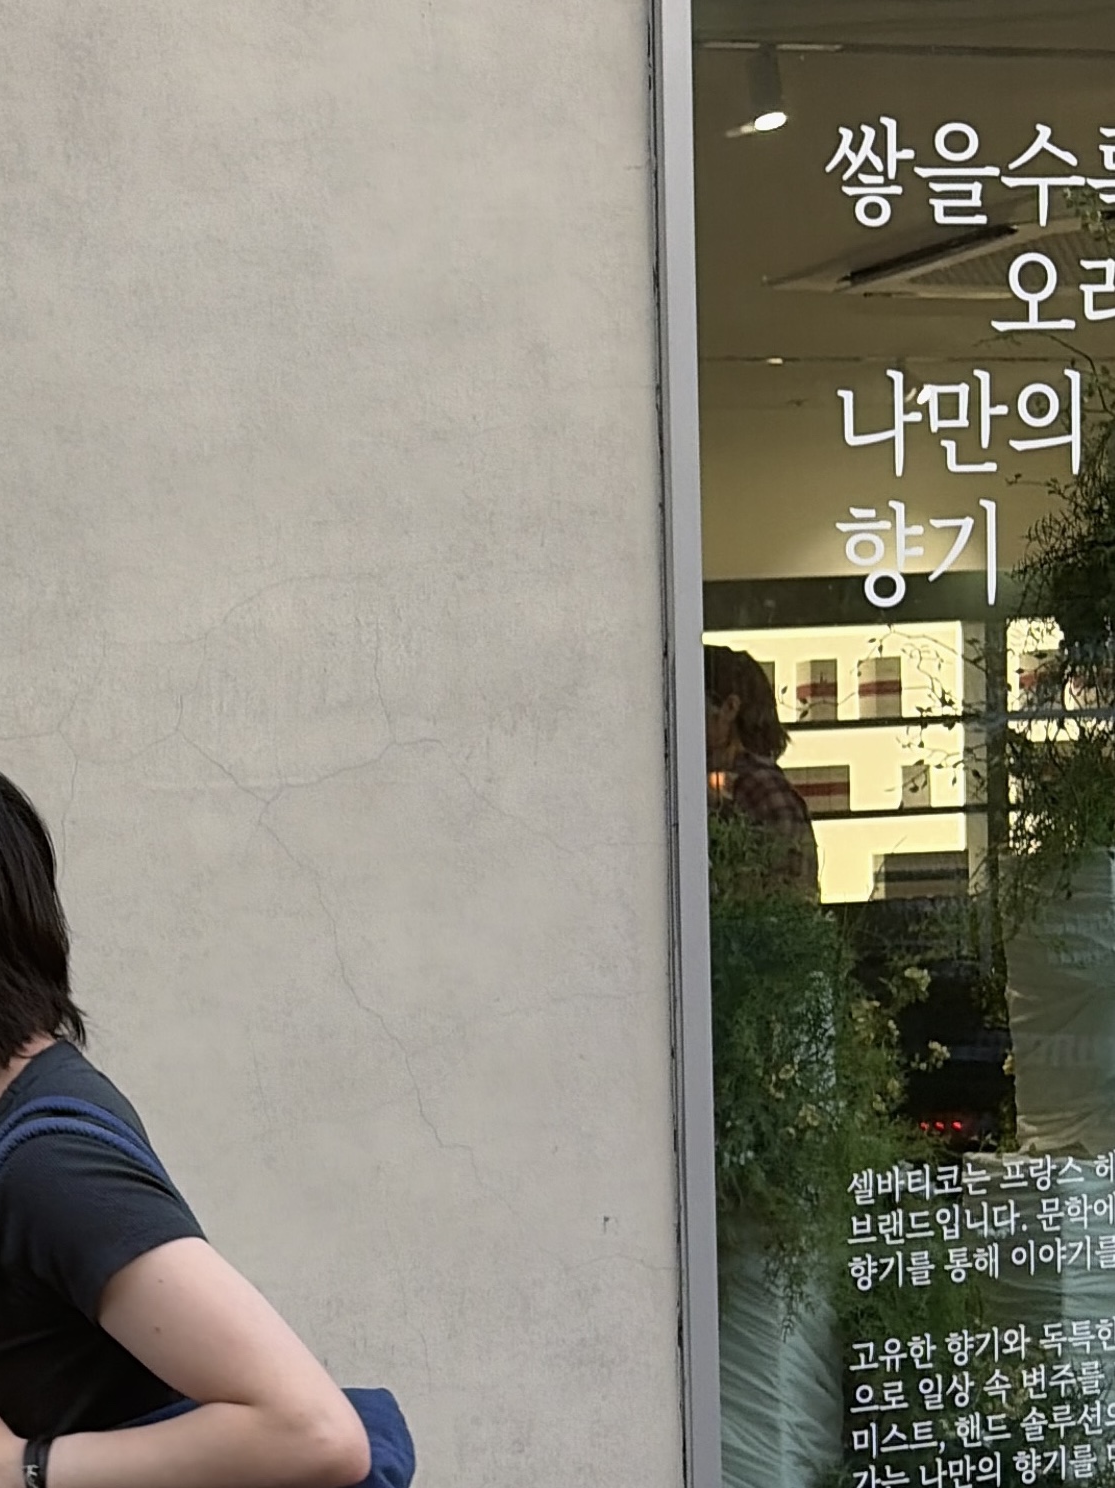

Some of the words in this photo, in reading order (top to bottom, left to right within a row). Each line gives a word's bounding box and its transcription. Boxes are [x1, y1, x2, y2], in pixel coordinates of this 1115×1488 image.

[837, 368, 1081, 477] 나만의
[836, 498, 997, 608] 향기
[847, 1163, 991, 1205] 셀바티코는
[999, 1154, 1085, 1192] 프랑스
[847, 1199, 1028, 1245] 브랜드입니다.
[848, 1251, 935, 1292] 향기를
[944, 1241, 999, 1284] 통해
[849, 1332, 937, 1374] 고유한
[944, 1323, 1031, 1364] 향기와
[850, 1380, 909, 1414] 으로
[918, 1371, 975, 1411] 일상
[983, 1368, 1012, 1405] 속
[1021, 1360, 1105, 1400] 변주를
[852, 1420, 946, 1460] 미스트,
[954, 1410, 1012, 1449] 핸드
[1012, 1444, 1098, 1485] 향기를
